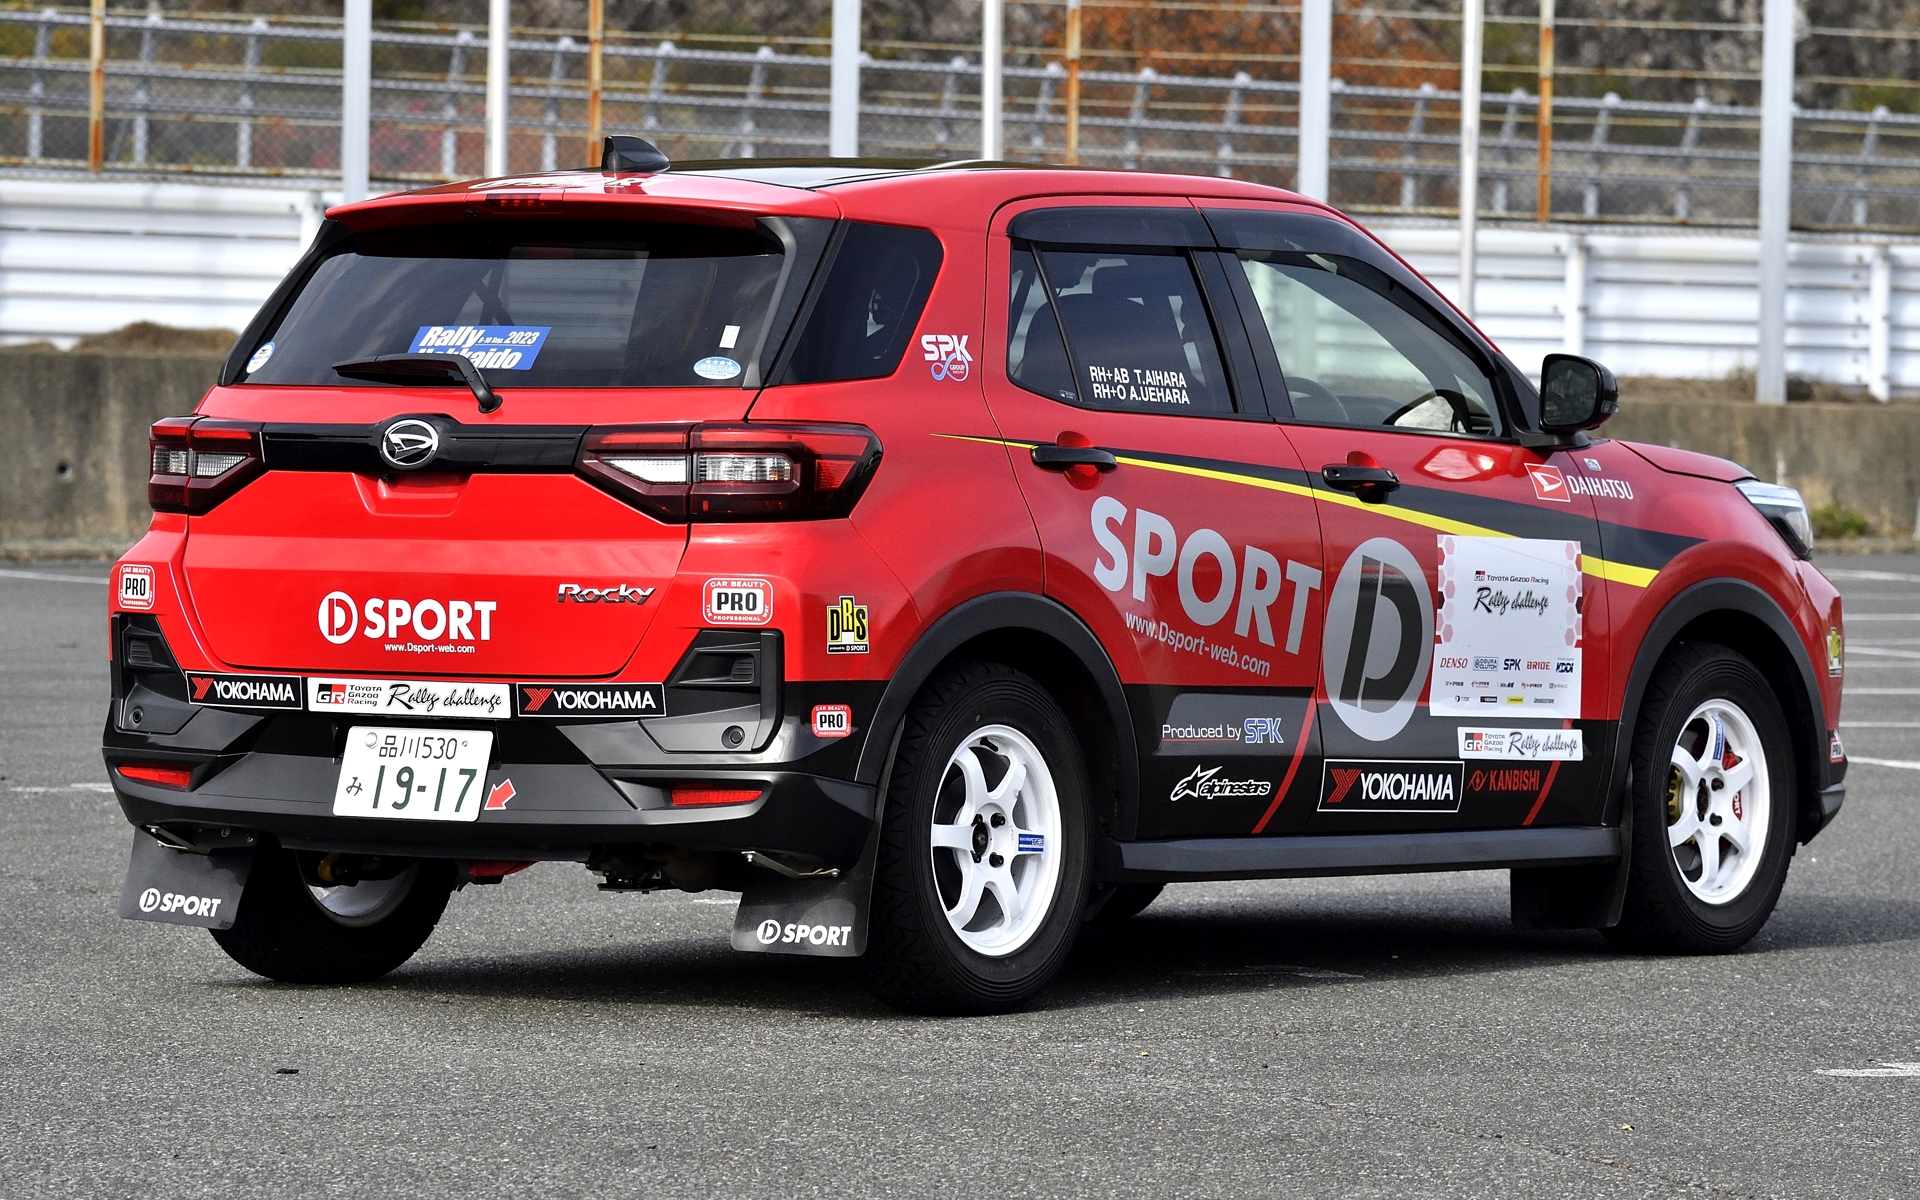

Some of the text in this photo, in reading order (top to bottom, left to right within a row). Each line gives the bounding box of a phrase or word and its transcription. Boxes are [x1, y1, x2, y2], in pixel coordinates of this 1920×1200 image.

[419, 326, 486, 348] Rally
[503, 331, 541, 345] 2023
[921, 334, 974, 361] SPK
[1089, 366, 1187, 388] RH+AB T.AIHARA
[1093, 383, 1127, 400] RH+O
[1129, 386, 1191, 405] A.UEHARA
[1566, 475, 1634, 500] DAIHATSU
[1090, 495, 1323, 655] SPORT
[1487, 574, 1509, 582] TOYOTA
[1509, 575, 1530, 583] GAZOO
[1530, 576, 1549, 585] Racing
[125, 577, 146, 596] PRO
[558, 583, 656, 605] Rocky
[717, 591, 757, 611] PRO
[1473, 586, 1549, 616] Rally challenge
[363, 597, 497, 641] SPORT
[829, 599, 867, 641] DRS
[384, 642, 475, 654] www.Dsport-web.com
[1125, 611, 1271, 678] www.Dsport-web.com
[1440, 657, 1468, 669] DENSO
[1503, 658, 1521, 671] SPK
[1526, 661, 1551, 670] BRIDE
[213, 680, 295, 702] YOKOHAMA
[317, 690, 346, 704] GR
[348, 691, 379, 699] GAZOO
[349, 684, 382, 692] TOYOTA
[386, 683, 502, 714] Rally challenge
[347, 698, 378, 707] Racing
[553, 690, 657, 710] YOKOHAMA
[819, 713, 844, 728] PRO
[1162, 718, 1284, 743] Produced by SPK
[1464, 739, 1483, 751] GR
[1483, 745, 1503, 754] Racing
[1508, 731, 1578, 758] Rally challenge
[346, 765, 477, 813] み 19-17
[1200, 778, 1271, 800] alpinestars
[1360, 773, 1454, 801] YOKOHAMA
[1489, 769, 1541, 792] KANBISHI
[159, 892, 222, 918] SPORT
[781, 923, 852, 946] SPORT
